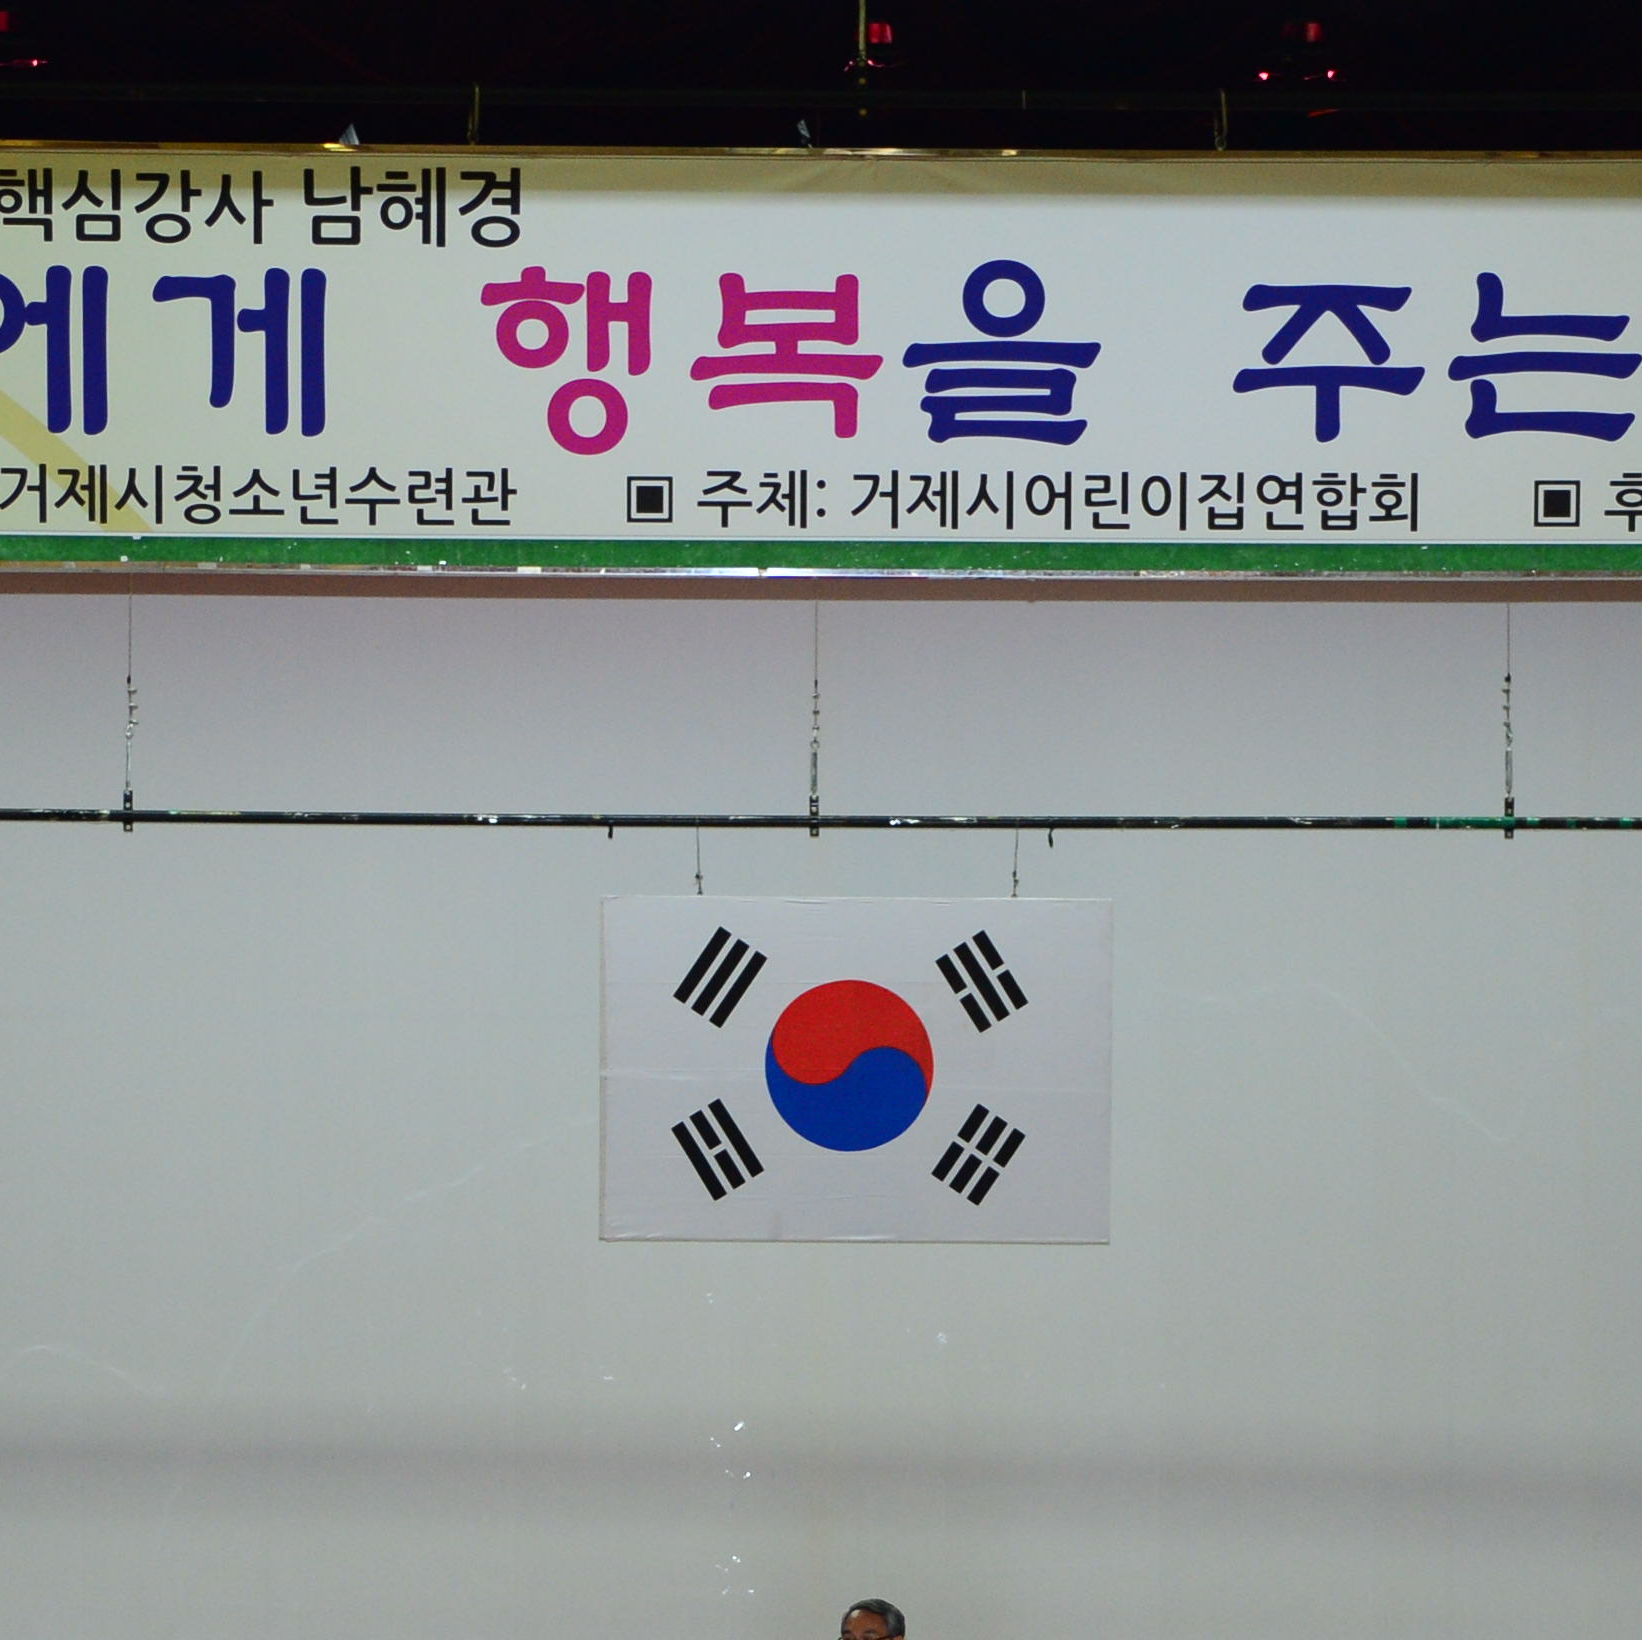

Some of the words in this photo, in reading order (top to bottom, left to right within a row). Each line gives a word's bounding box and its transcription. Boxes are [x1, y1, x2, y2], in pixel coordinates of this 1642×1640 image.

[303, 166, 521, 248] 남혜경
[480, 259, 1102, 455] 행복을
[1232, 272, 1642, 443] 주는
[0, 463, 517, 526] 거제시청소년수련관
[697, 469, 826, 529] 주체:
[851, 470, 1418, 532] 거제시어린이집연합회
